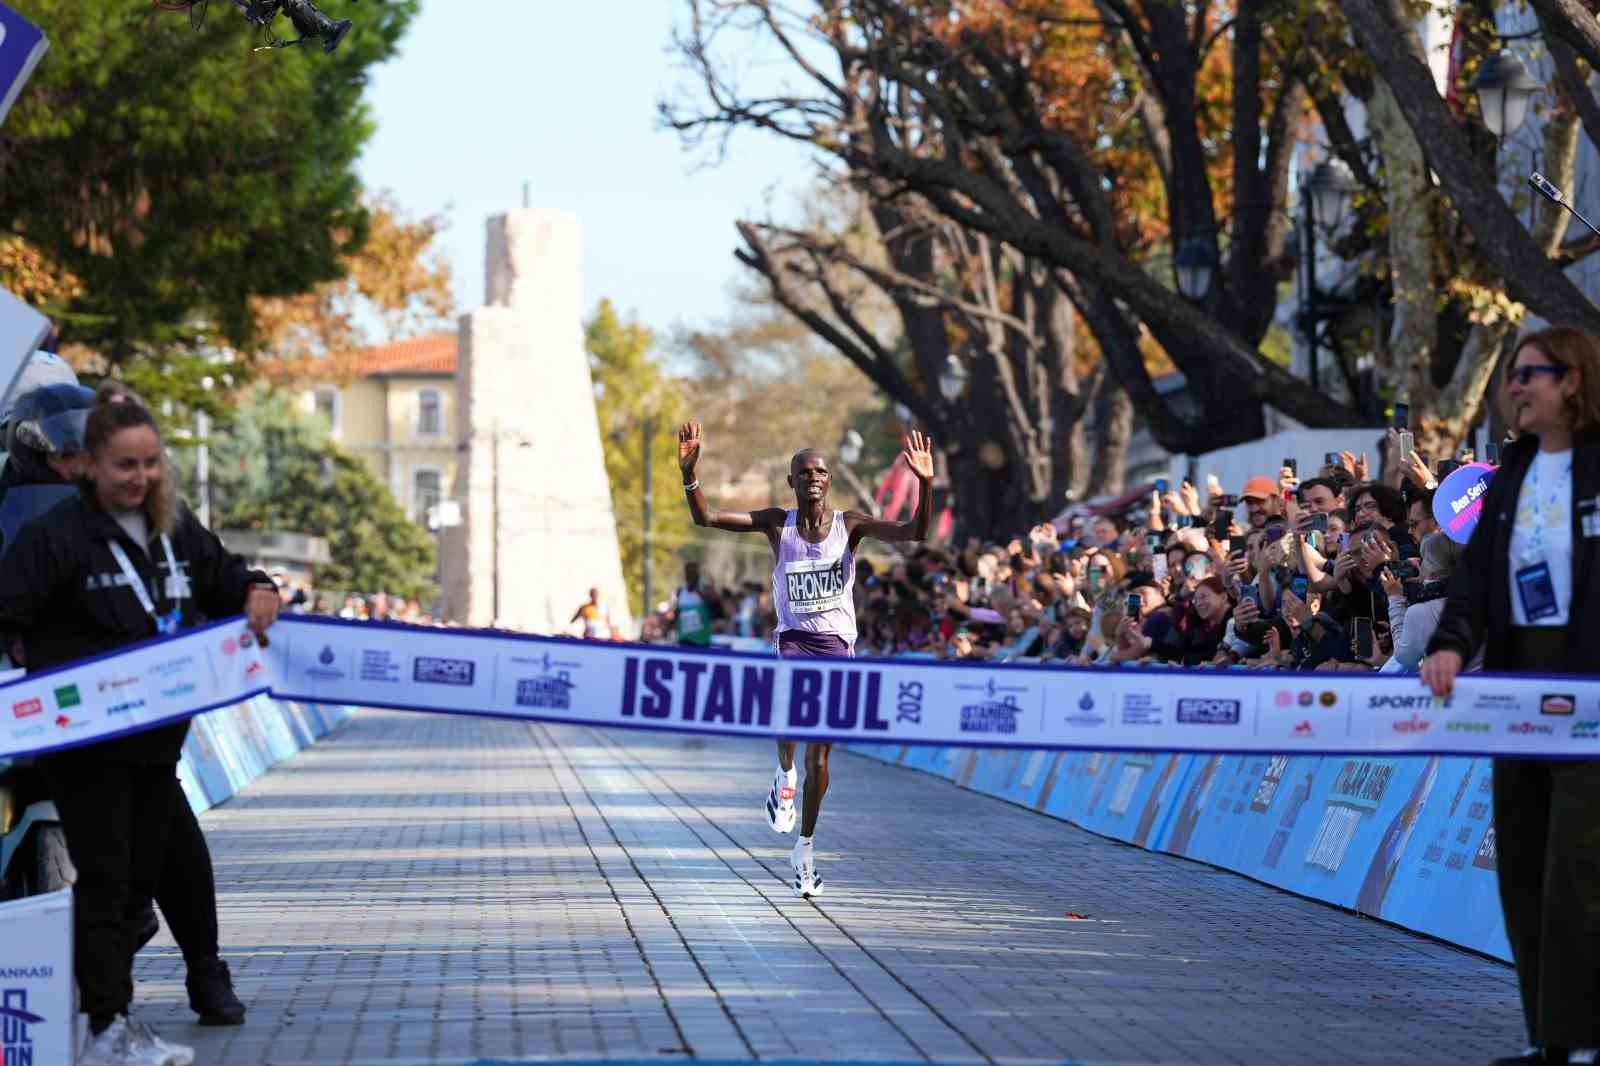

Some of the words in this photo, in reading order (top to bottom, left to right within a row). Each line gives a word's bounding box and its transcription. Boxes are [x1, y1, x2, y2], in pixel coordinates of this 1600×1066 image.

[1450, 494, 1471, 514] Ben
[1466, 478, 1488, 501] Seni
[788, 570, 843, 600] RHONZAS
[896, 681, 923, 724] 2025
